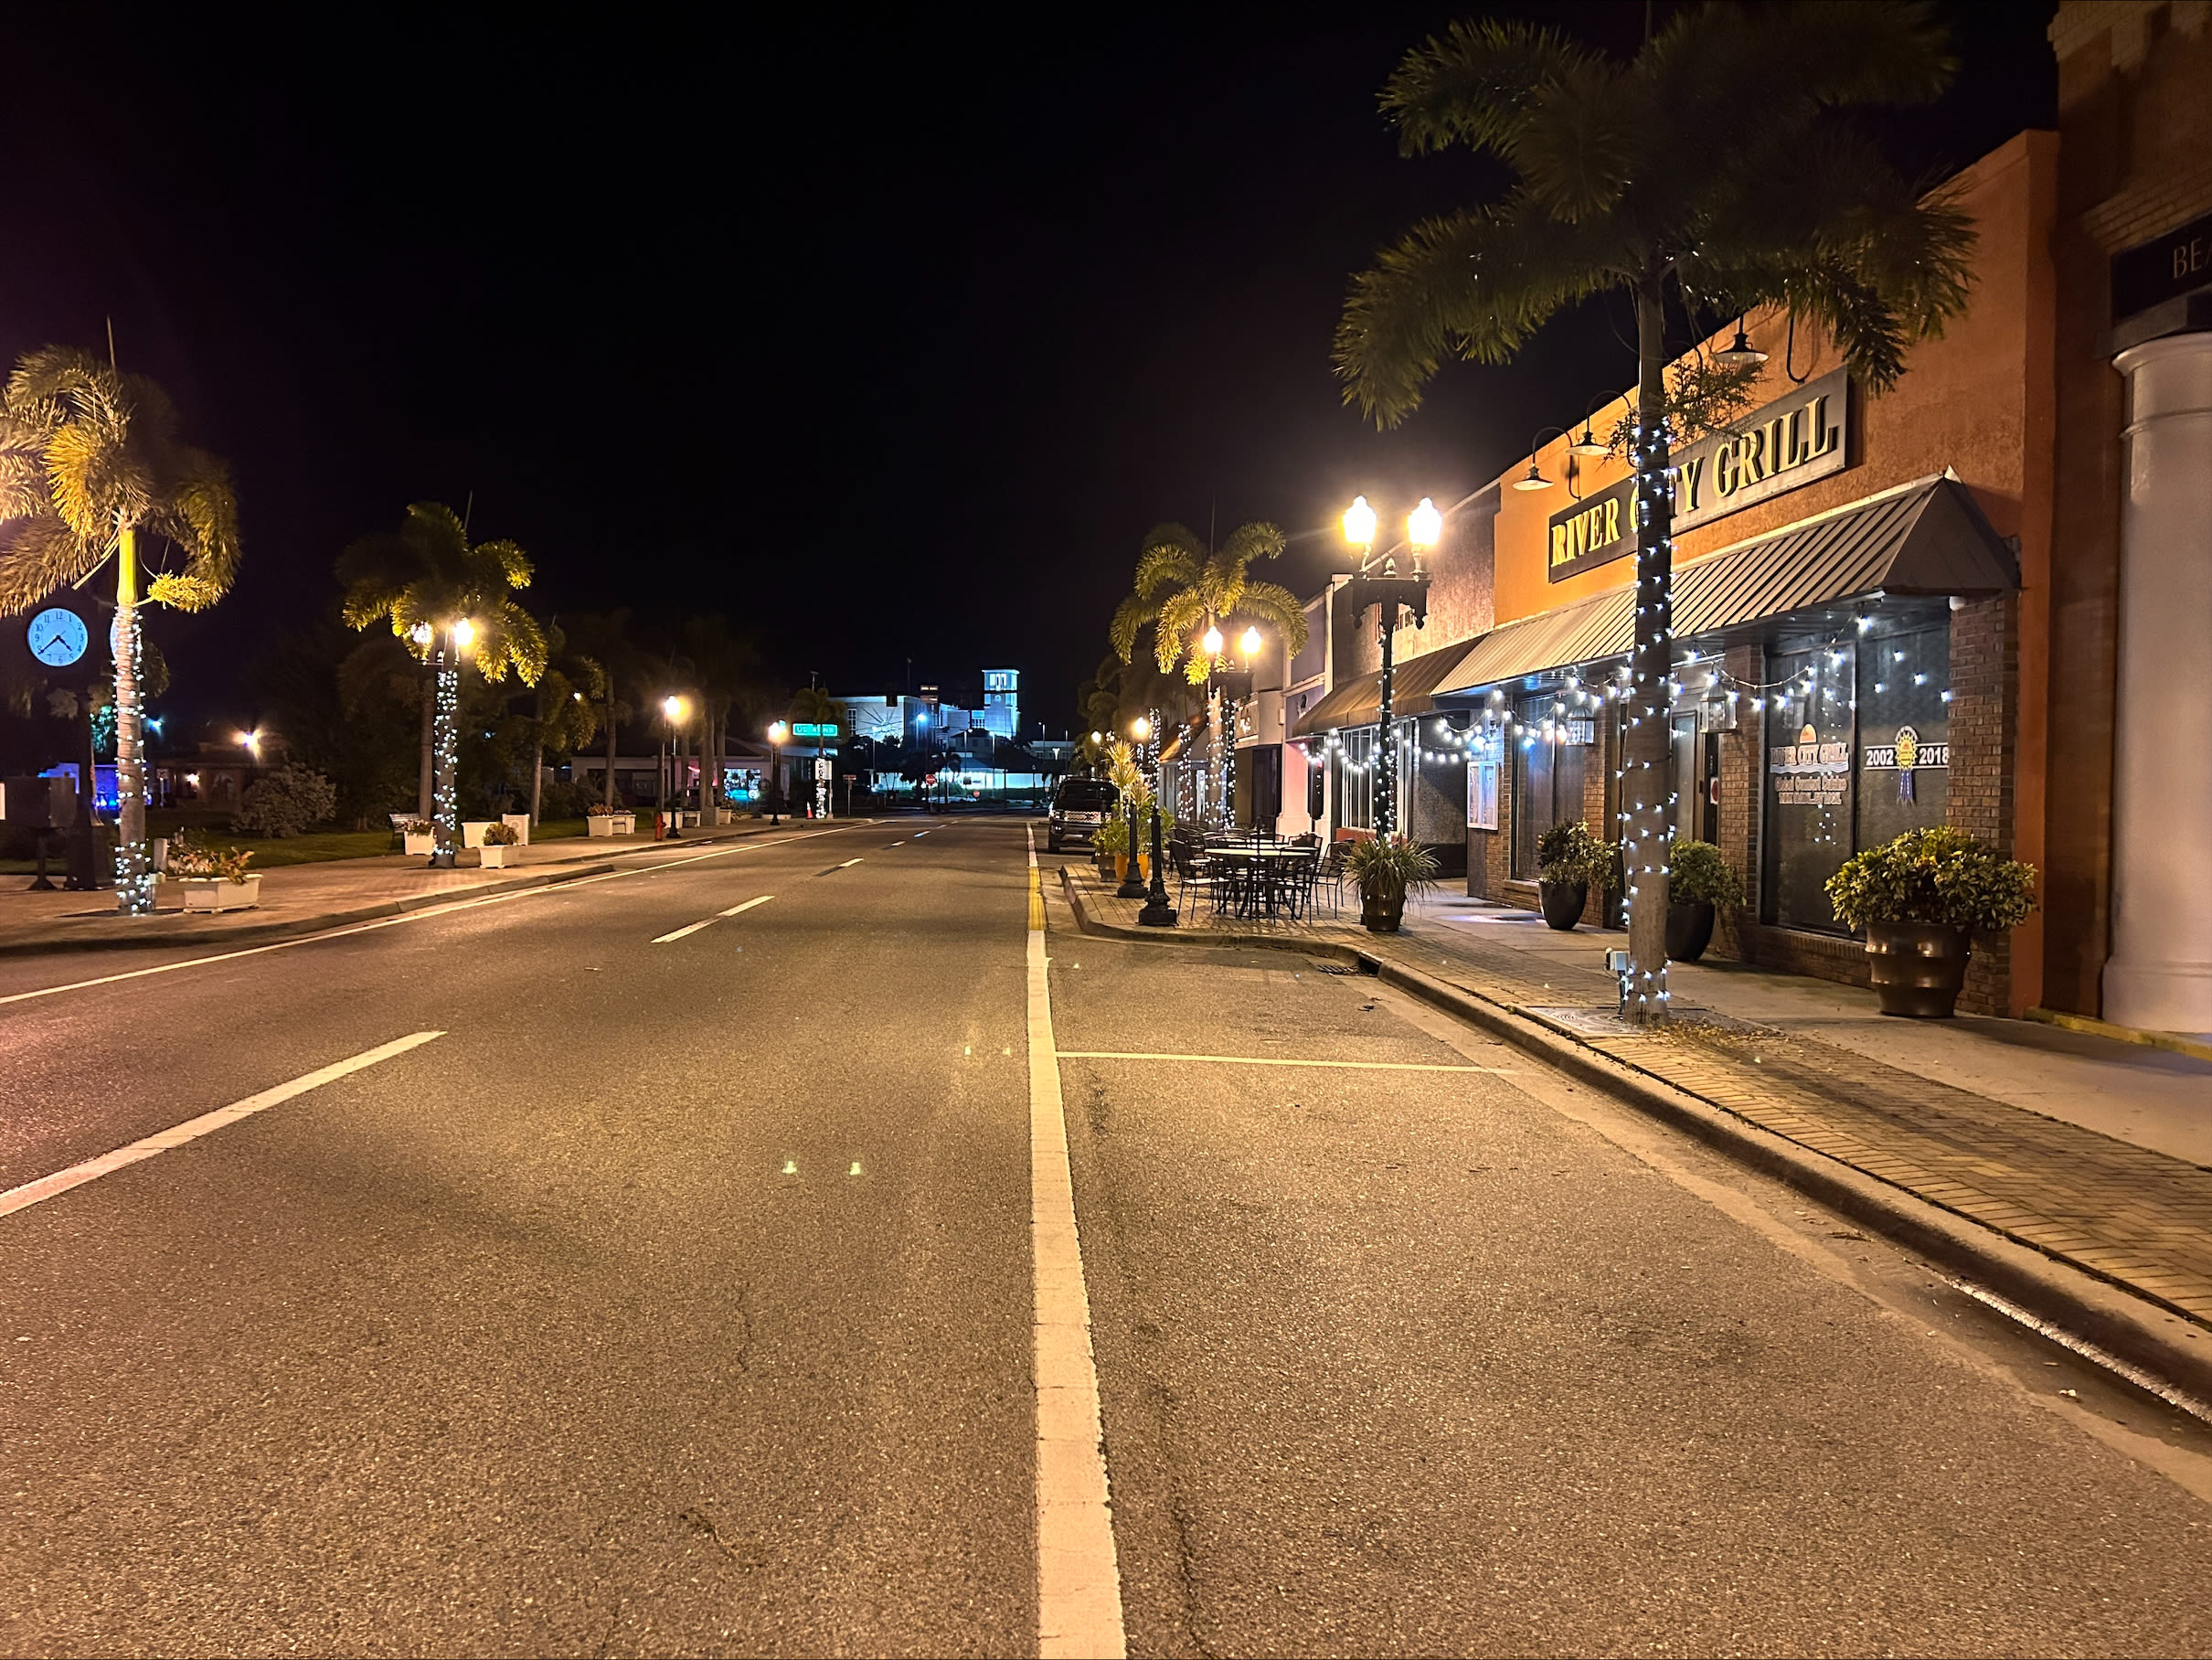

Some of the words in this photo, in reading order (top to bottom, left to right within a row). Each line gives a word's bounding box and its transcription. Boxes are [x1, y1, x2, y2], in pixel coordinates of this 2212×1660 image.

[1550, 497, 1621, 568] RIVER
[1629, 457, 1702, 533] CTY
[1712, 395, 1833, 498] GRILL
[44, 614, 50, 623] 11
[55, 612, 63, 620] 12
[36, 623, 43, 632] 10
[78, 622, 83, 631] 2
[35, 633, 40, 643] 9
[80, 633, 84, 642] 3
[77, 644, 82, 654] 4
[47, 654, 52, 662] 7
[58, 655, 63, 665] 6
[69, 653, 74, 661] 5
[1797, 744, 1820, 766] CITY
[1820, 743, 1849, 764] GRILL
[1866, 749, 1894, 766] 2002
[1919, 747, 1950, 765] 2018
